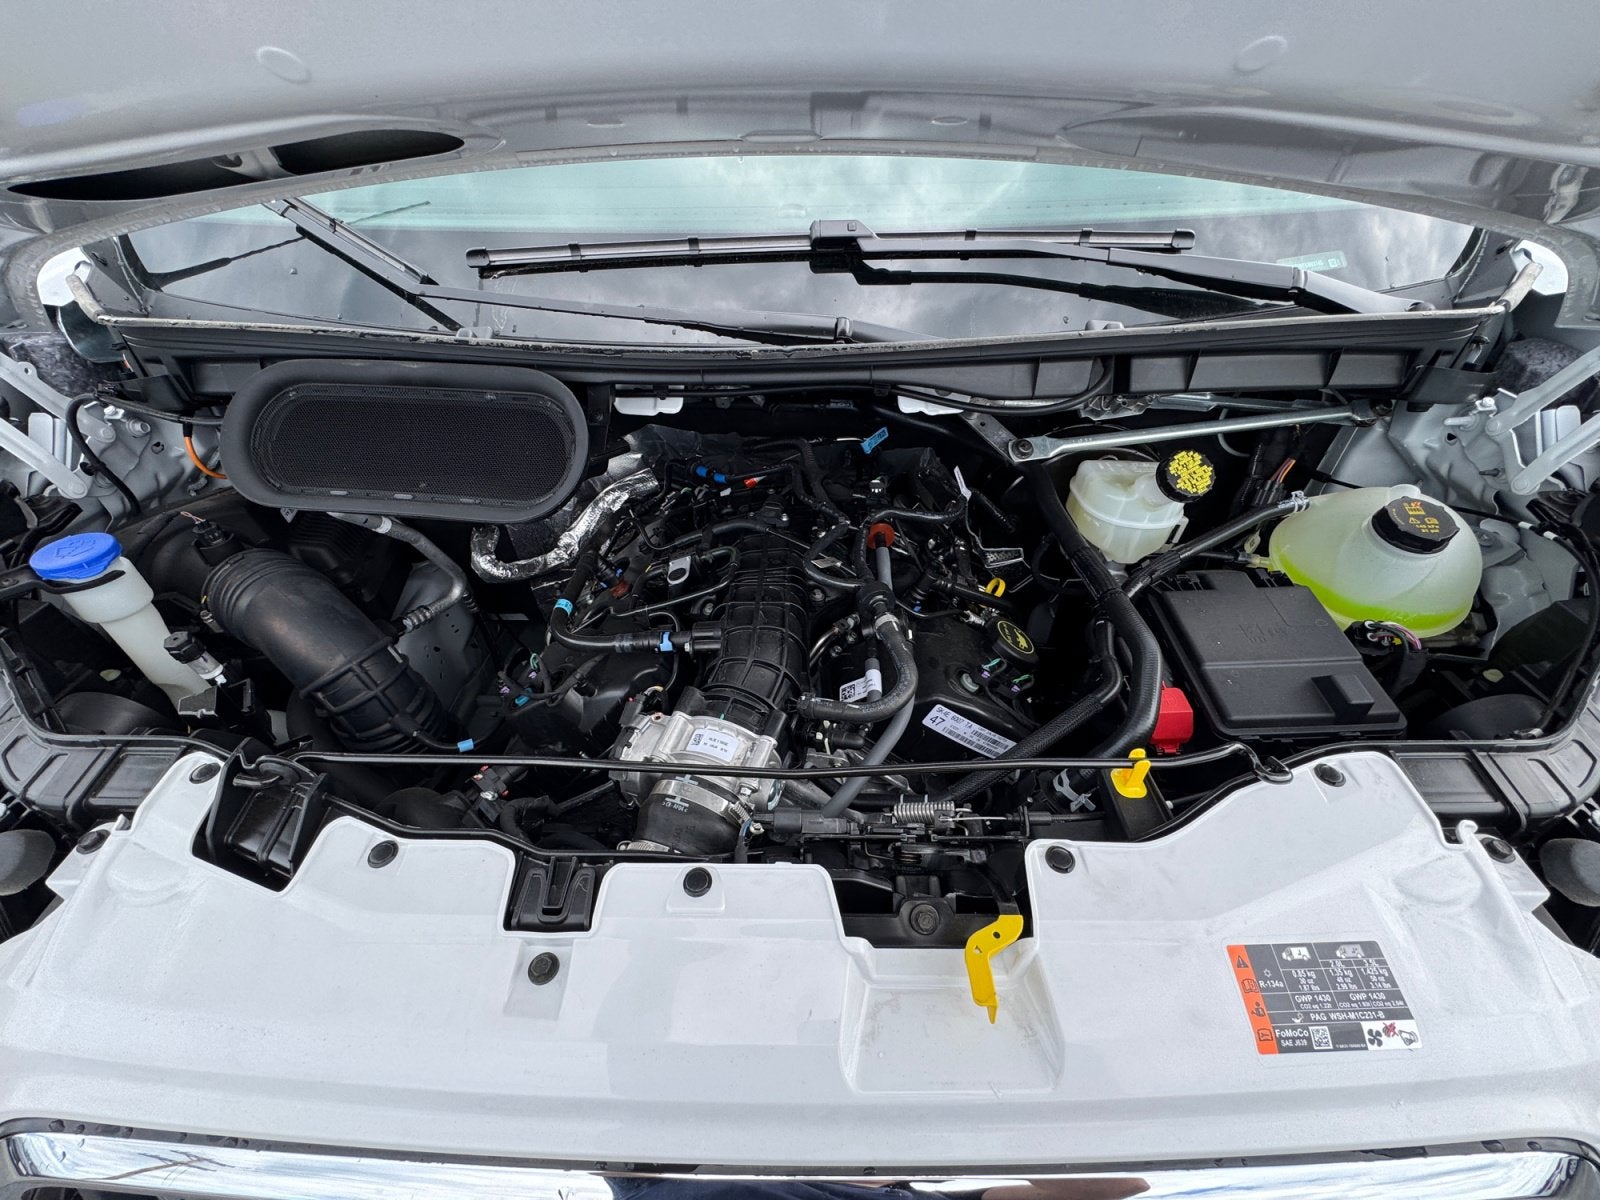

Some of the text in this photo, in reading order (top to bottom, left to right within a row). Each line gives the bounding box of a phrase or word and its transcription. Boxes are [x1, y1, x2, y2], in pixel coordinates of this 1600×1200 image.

[930, 716, 945, 726] 47
[1291, 970, 1317, 979] 0.85 kg
[1344, 969, 1353, 978] kg
[1361, 968, 1389, 977] 1.425 kg
[1259, 980, 1284, 989] R-134a
[1294, 994, 1332, 1003] GWP 1430
[1349, 992, 1386, 1001] GWP 1430
[1310, 1011, 1386, 1021] PAG WSH-M1C231-B
[1275, 1028, 1309, 1038] FoMoCo
[1281, 1039, 1294, 1047] SAE
